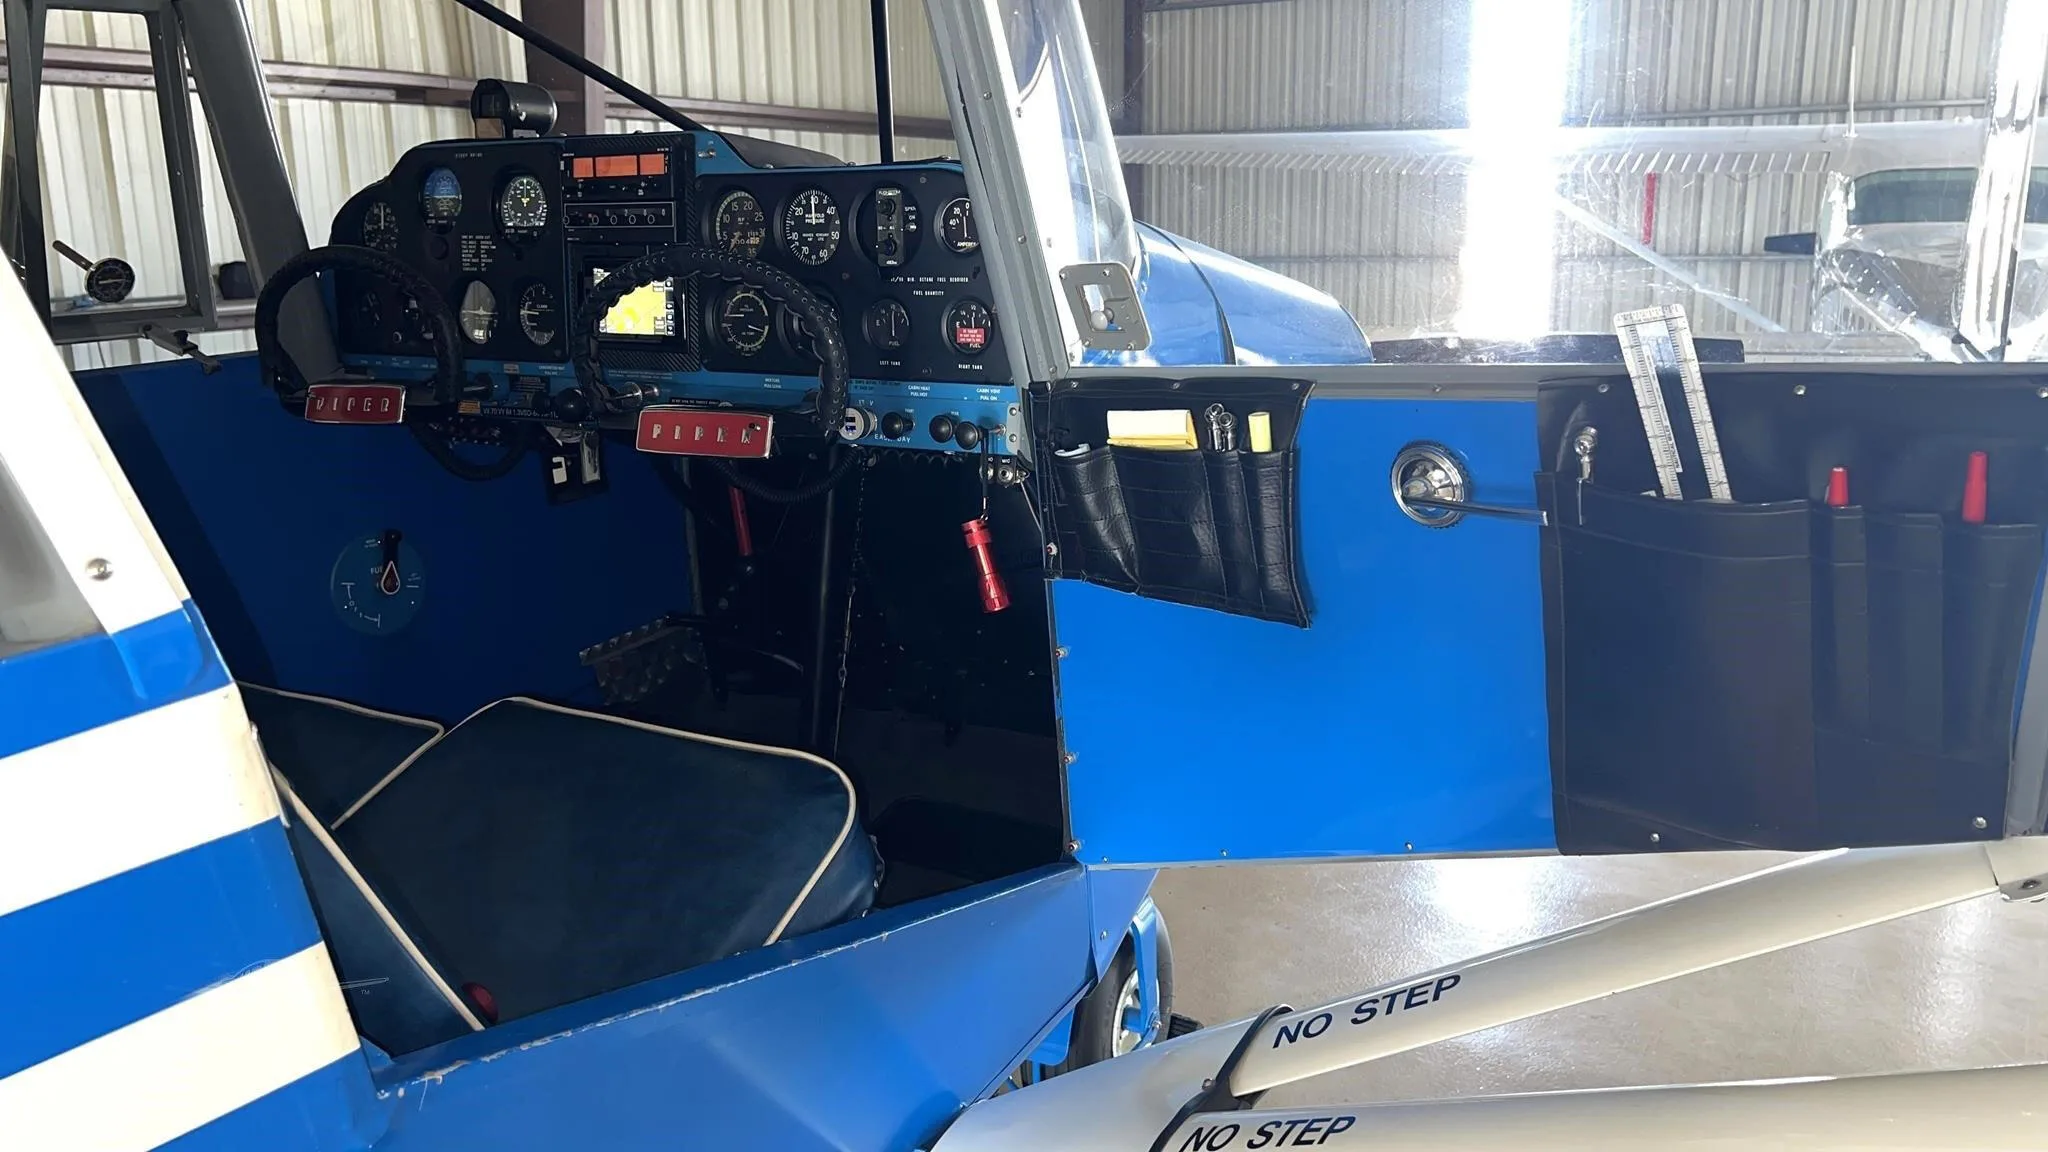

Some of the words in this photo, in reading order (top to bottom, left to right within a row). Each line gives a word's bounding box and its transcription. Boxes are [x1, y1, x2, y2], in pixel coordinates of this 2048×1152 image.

[743, 201, 753, 211] 20
[795, 207, 804, 216] 20
[722, 214, 731, 224] 10
[754, 211, 765, 222] 25
[722, 232, 728, 241] 5
[831, 231, 840, 240] 50
[801, 246, 809, 255] 70
[819, 249, 828, 258] 60
[1272, 1013, 1333, 1049] NO
[1350, 974, 1461, 1026] STEP
[1178, 1123, 1240, 1152] NO
[1246, 1116, 1356, 1149] STEP
